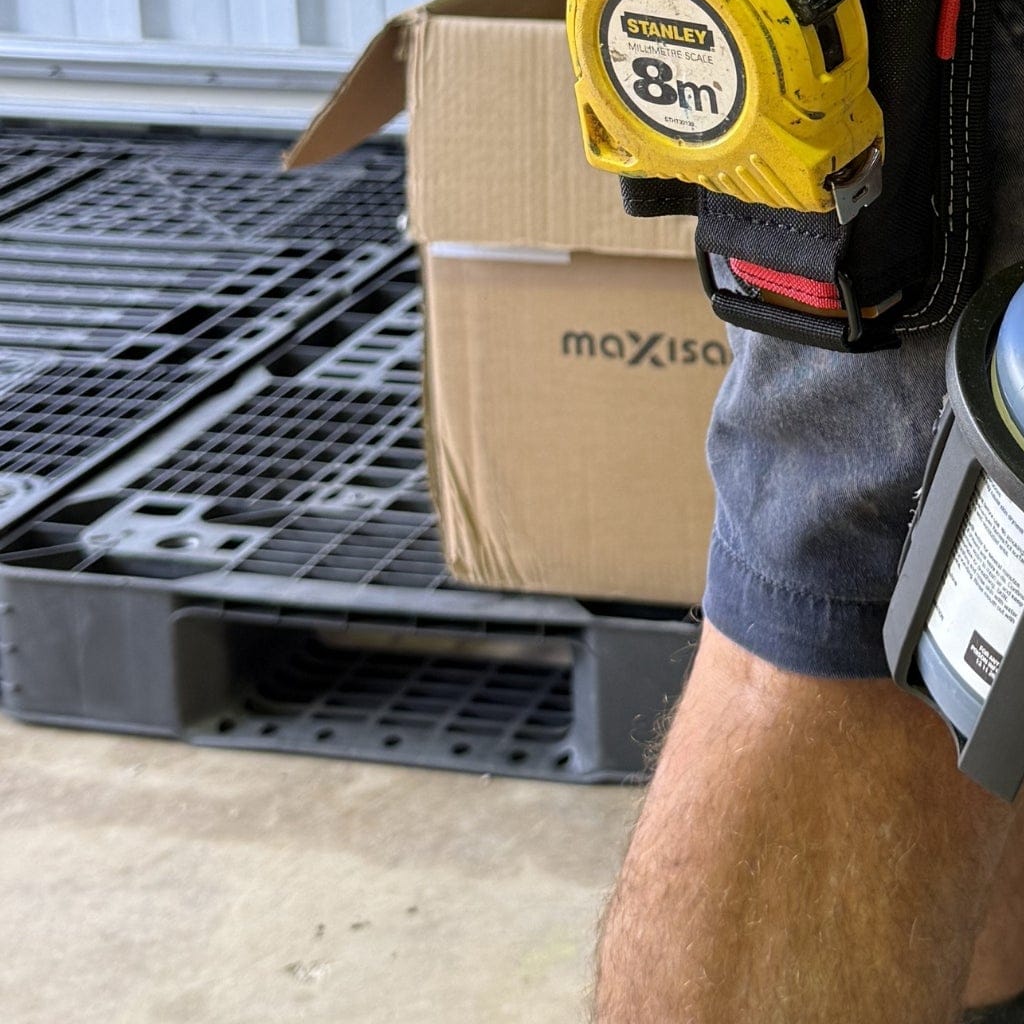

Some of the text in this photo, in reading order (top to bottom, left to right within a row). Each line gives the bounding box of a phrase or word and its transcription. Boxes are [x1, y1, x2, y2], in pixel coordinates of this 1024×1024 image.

[626, 17, 708, 45] STANLEY
[628, 42, 714, 64] MILLIMETRE SCALE
[631, 56, 719, 114] 8m
[562, 330, 731, 369] maXisa
